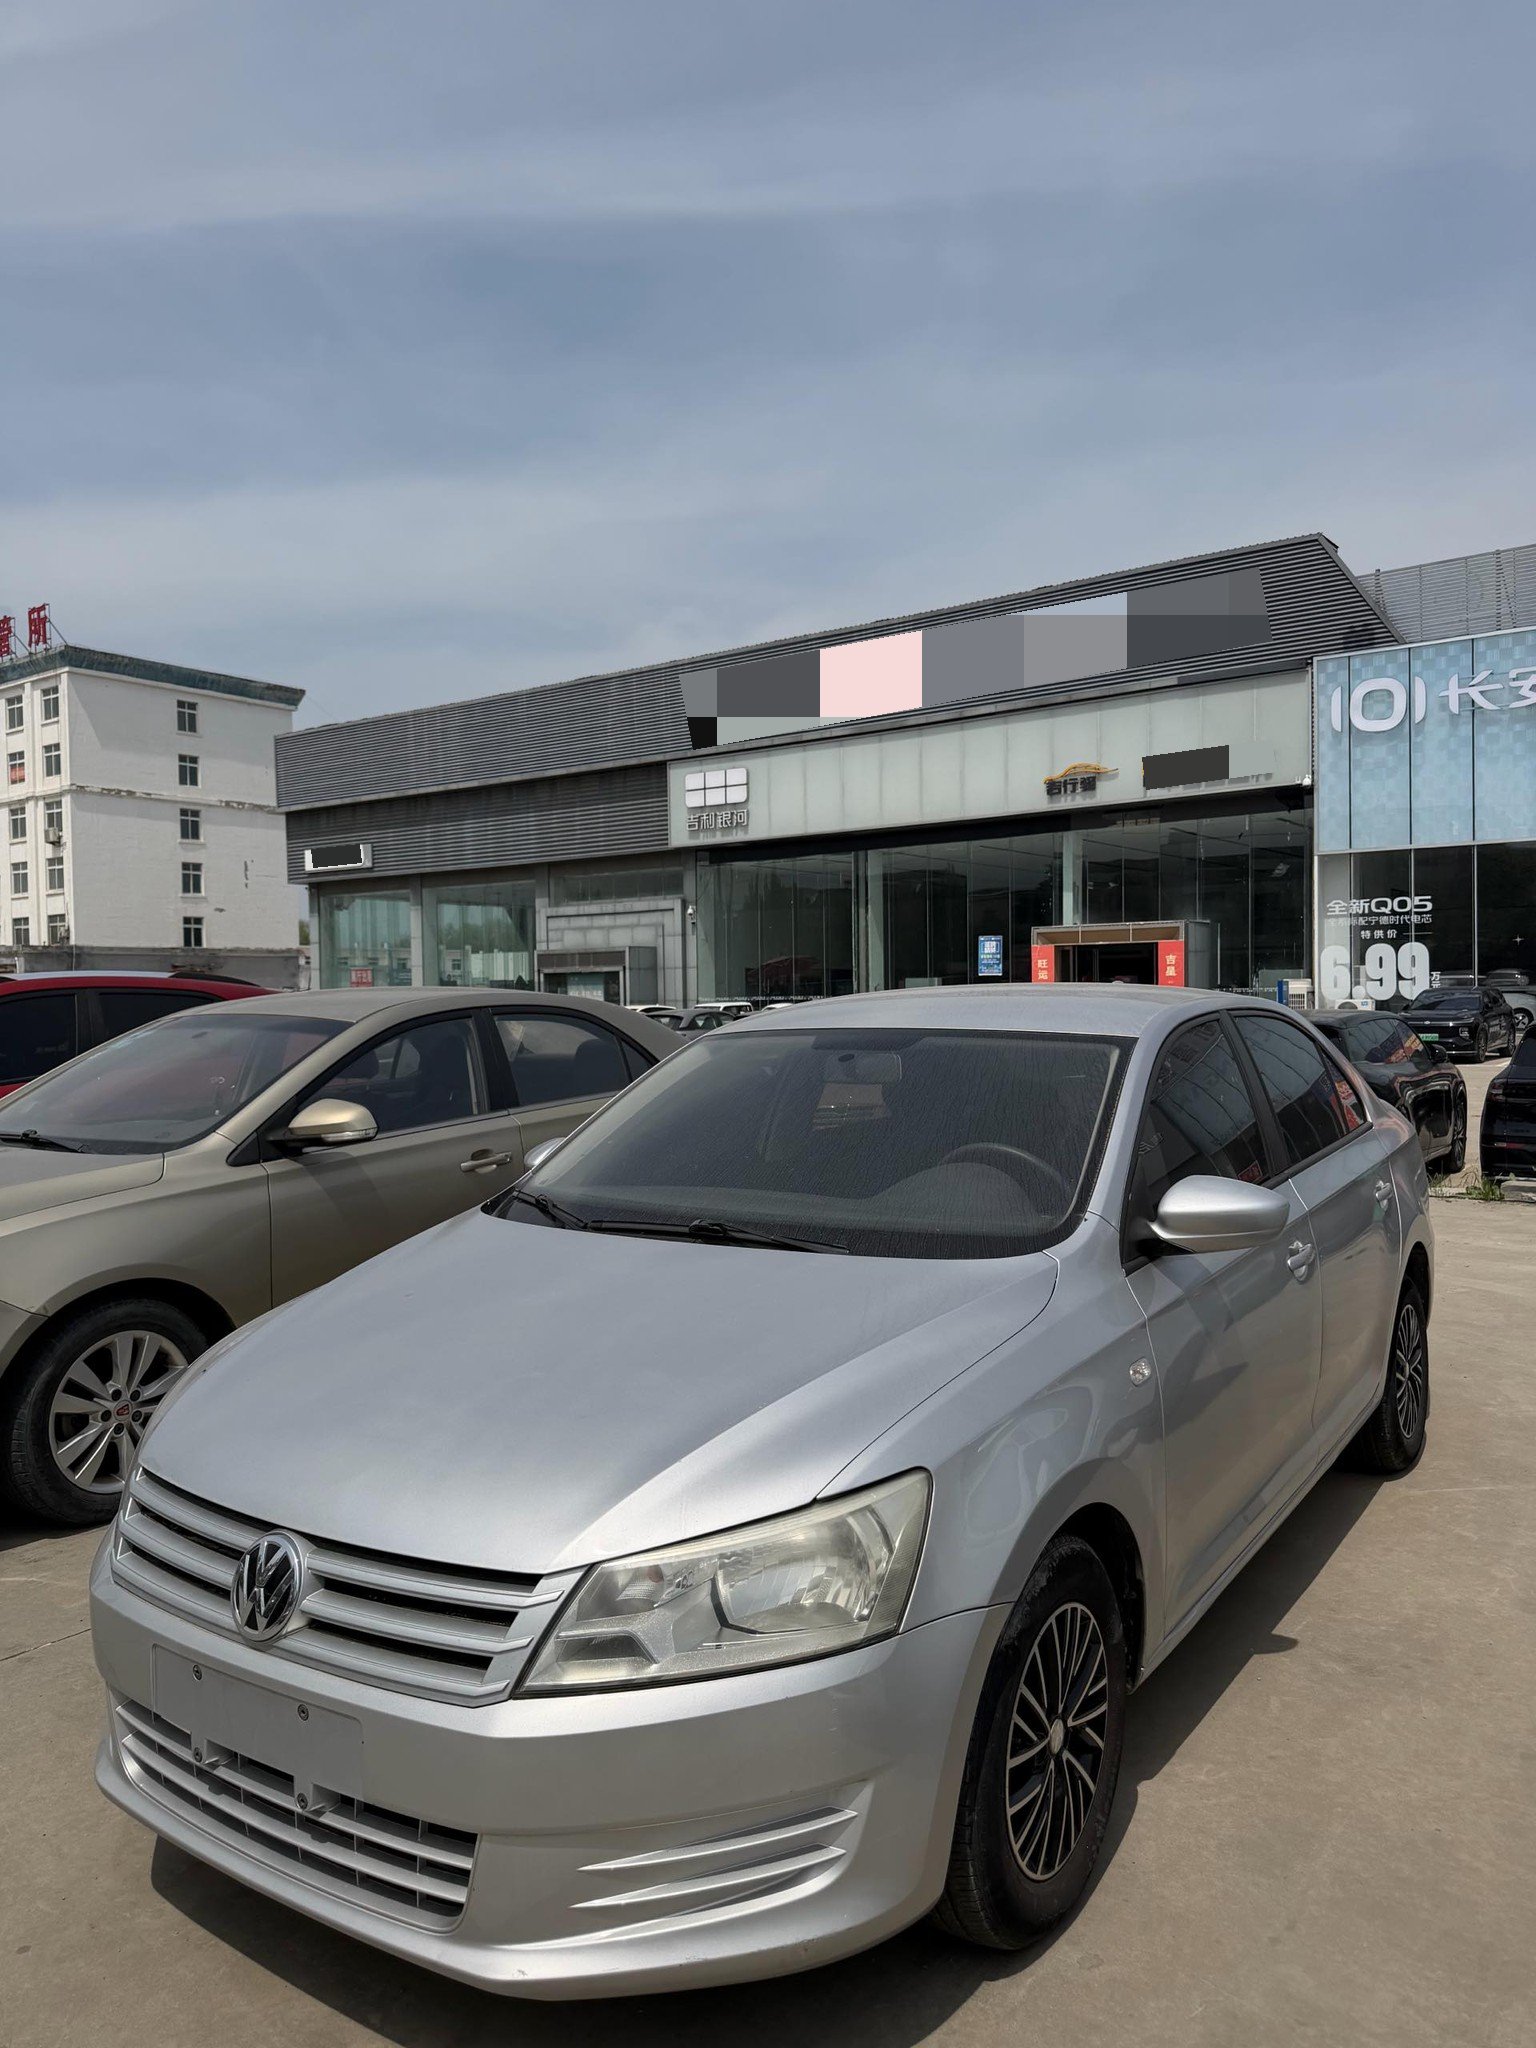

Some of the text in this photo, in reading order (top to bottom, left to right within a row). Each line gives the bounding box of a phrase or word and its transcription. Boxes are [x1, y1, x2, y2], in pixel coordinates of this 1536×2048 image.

[686, 809, 748, 831] 吉利银河
[1360, 929, 1397, 940] 特供价
[1320, 942, 1429, 1001] 6.99
